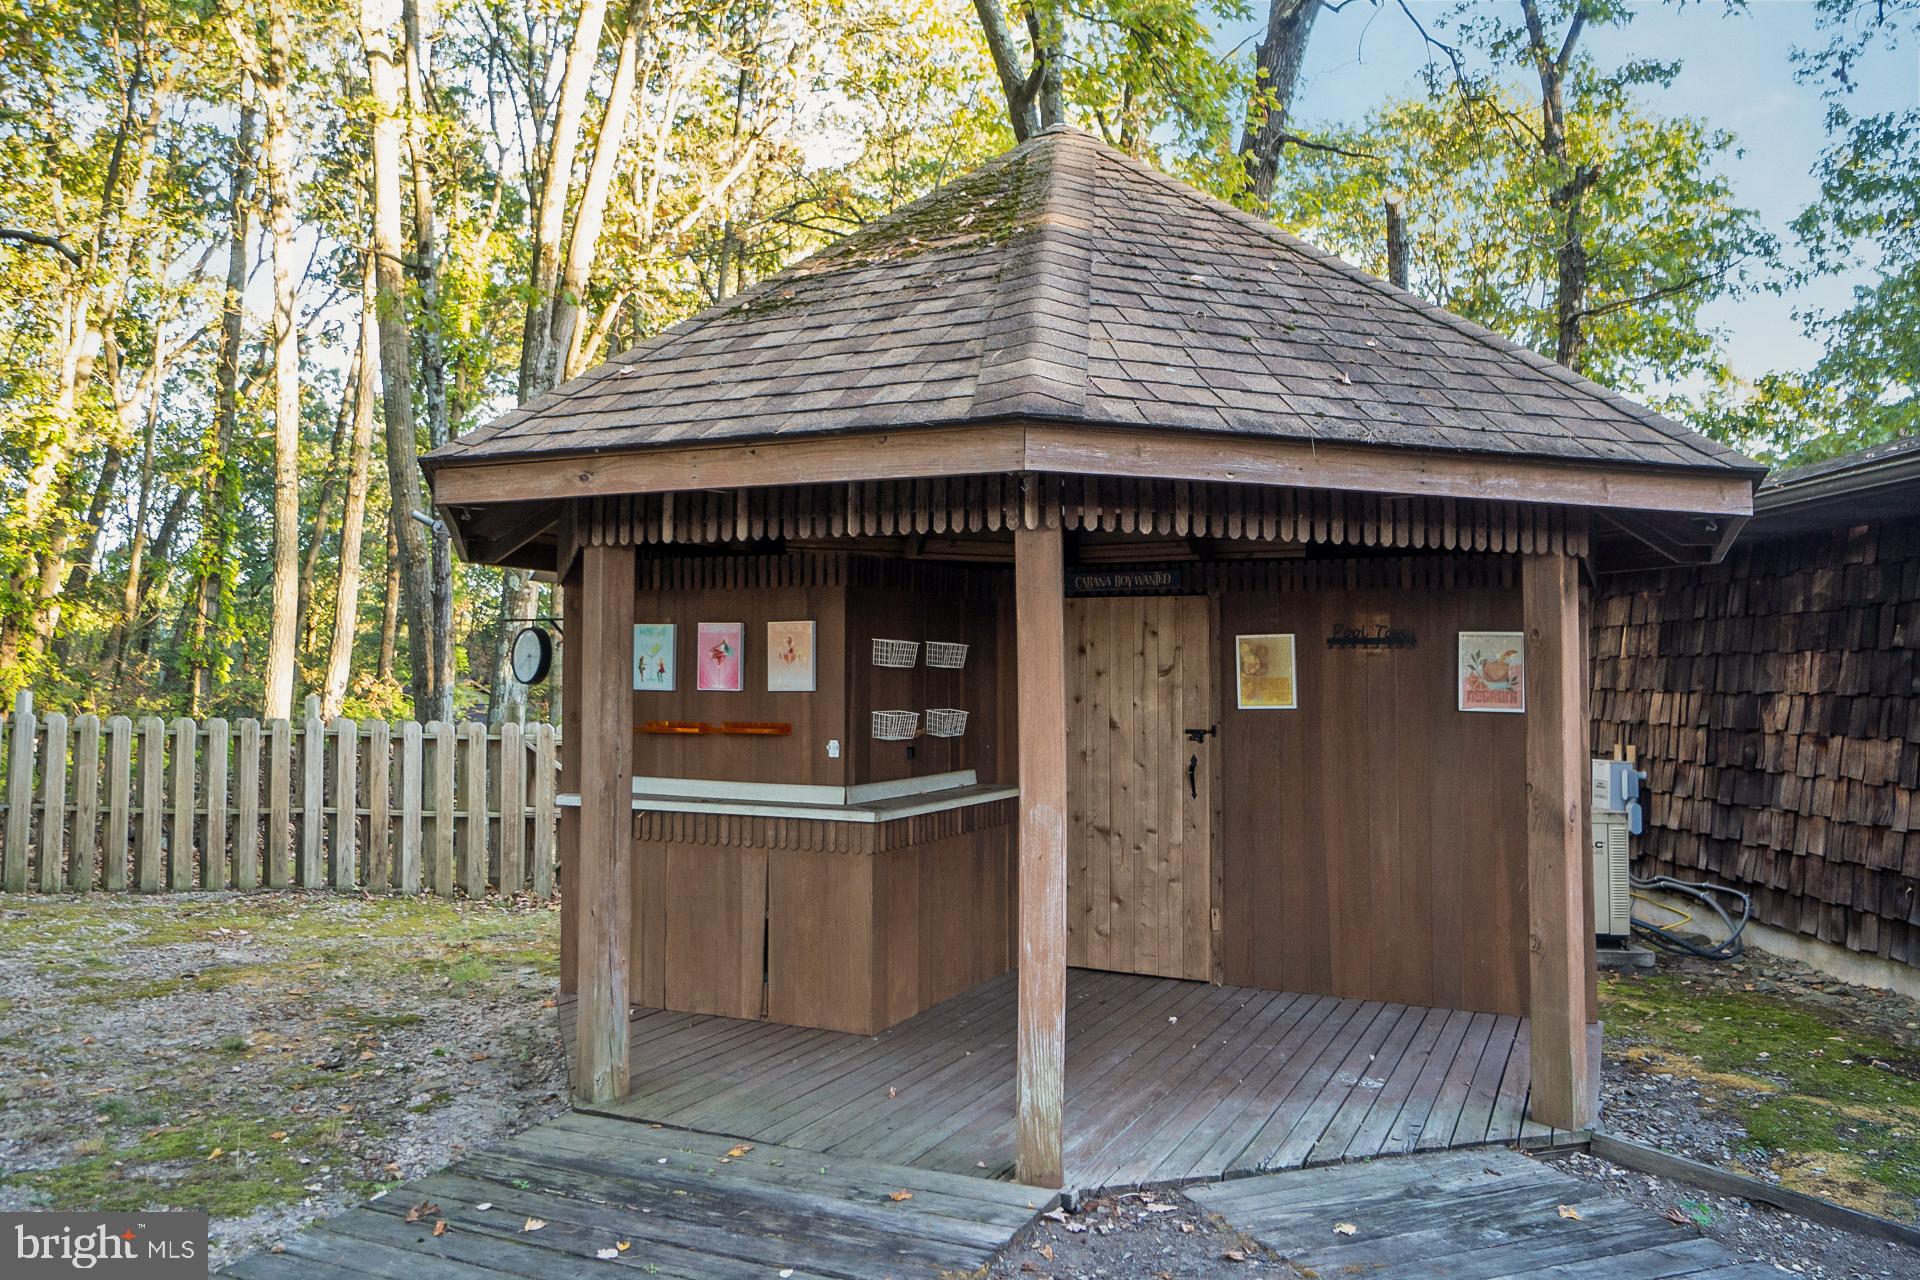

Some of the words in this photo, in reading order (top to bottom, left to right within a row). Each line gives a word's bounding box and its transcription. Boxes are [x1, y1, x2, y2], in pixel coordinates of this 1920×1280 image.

[1075, 575, 1112, 590] CABANA
[1114, 575, 1133, 588] BOY
[1134, 571, 1171, 586] WANTED
